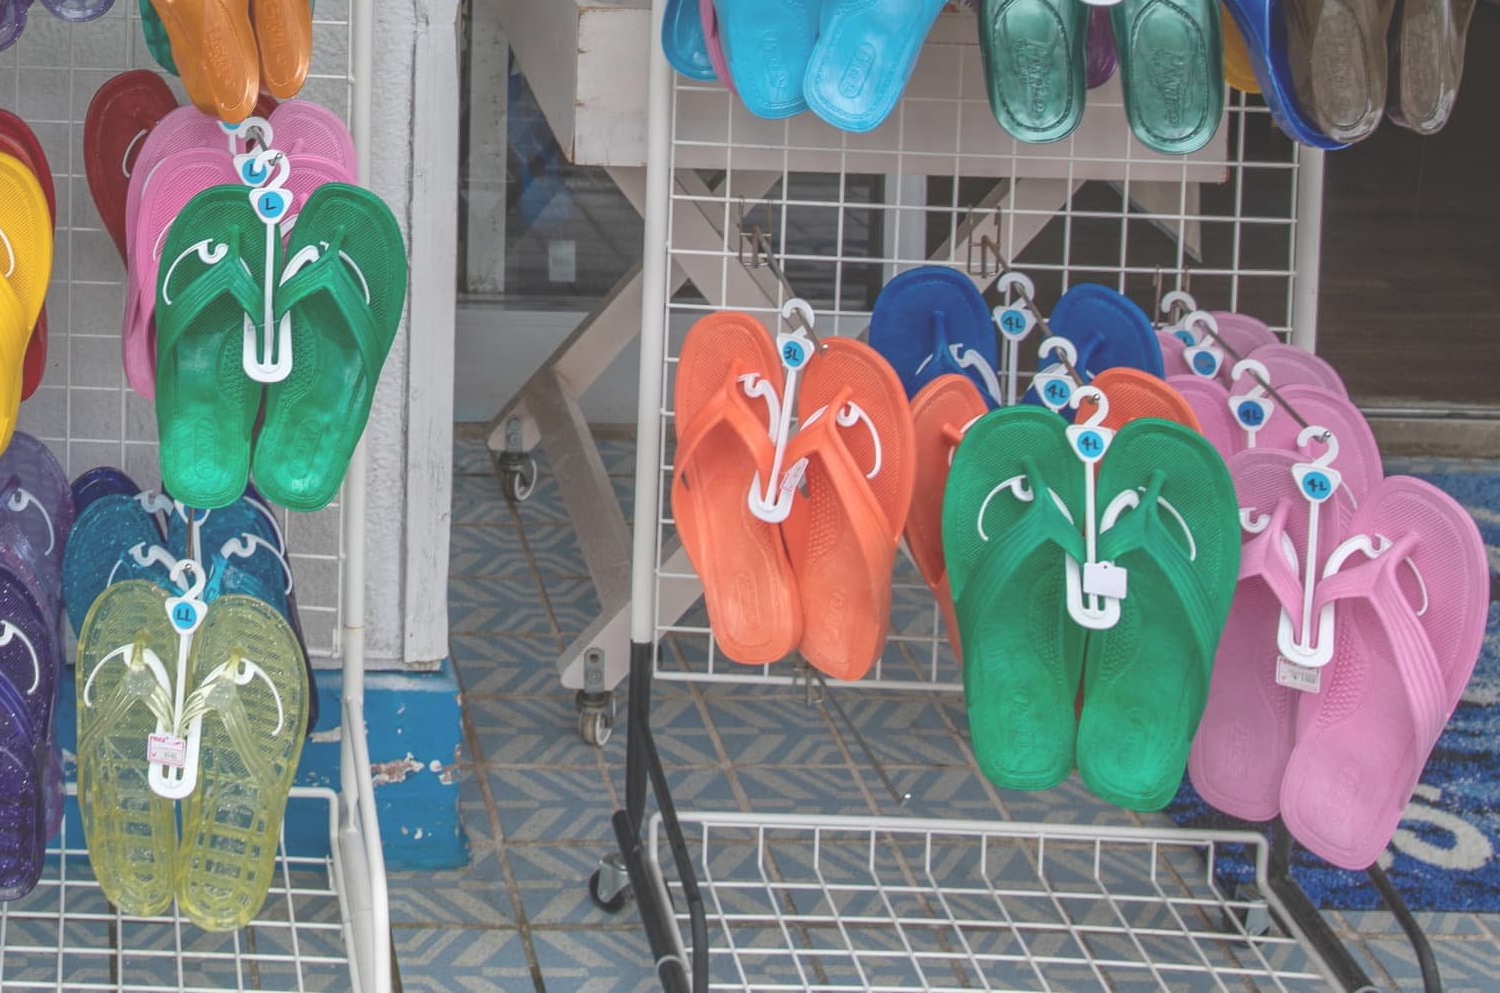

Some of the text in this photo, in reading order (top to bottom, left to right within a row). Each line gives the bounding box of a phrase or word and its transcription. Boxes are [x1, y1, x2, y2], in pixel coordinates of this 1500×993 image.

[265, 197, 277, 210] L
[1003, 316, 1027, 332] 4L
[783, 345, 800, 362] 3L
[1046, 383, 1067, 399] 4L
[1242, 407, 1261, 421] 4L
[1081, 435, 1101, 452] 4L
[1306, 477, 1328, 493] 4L
